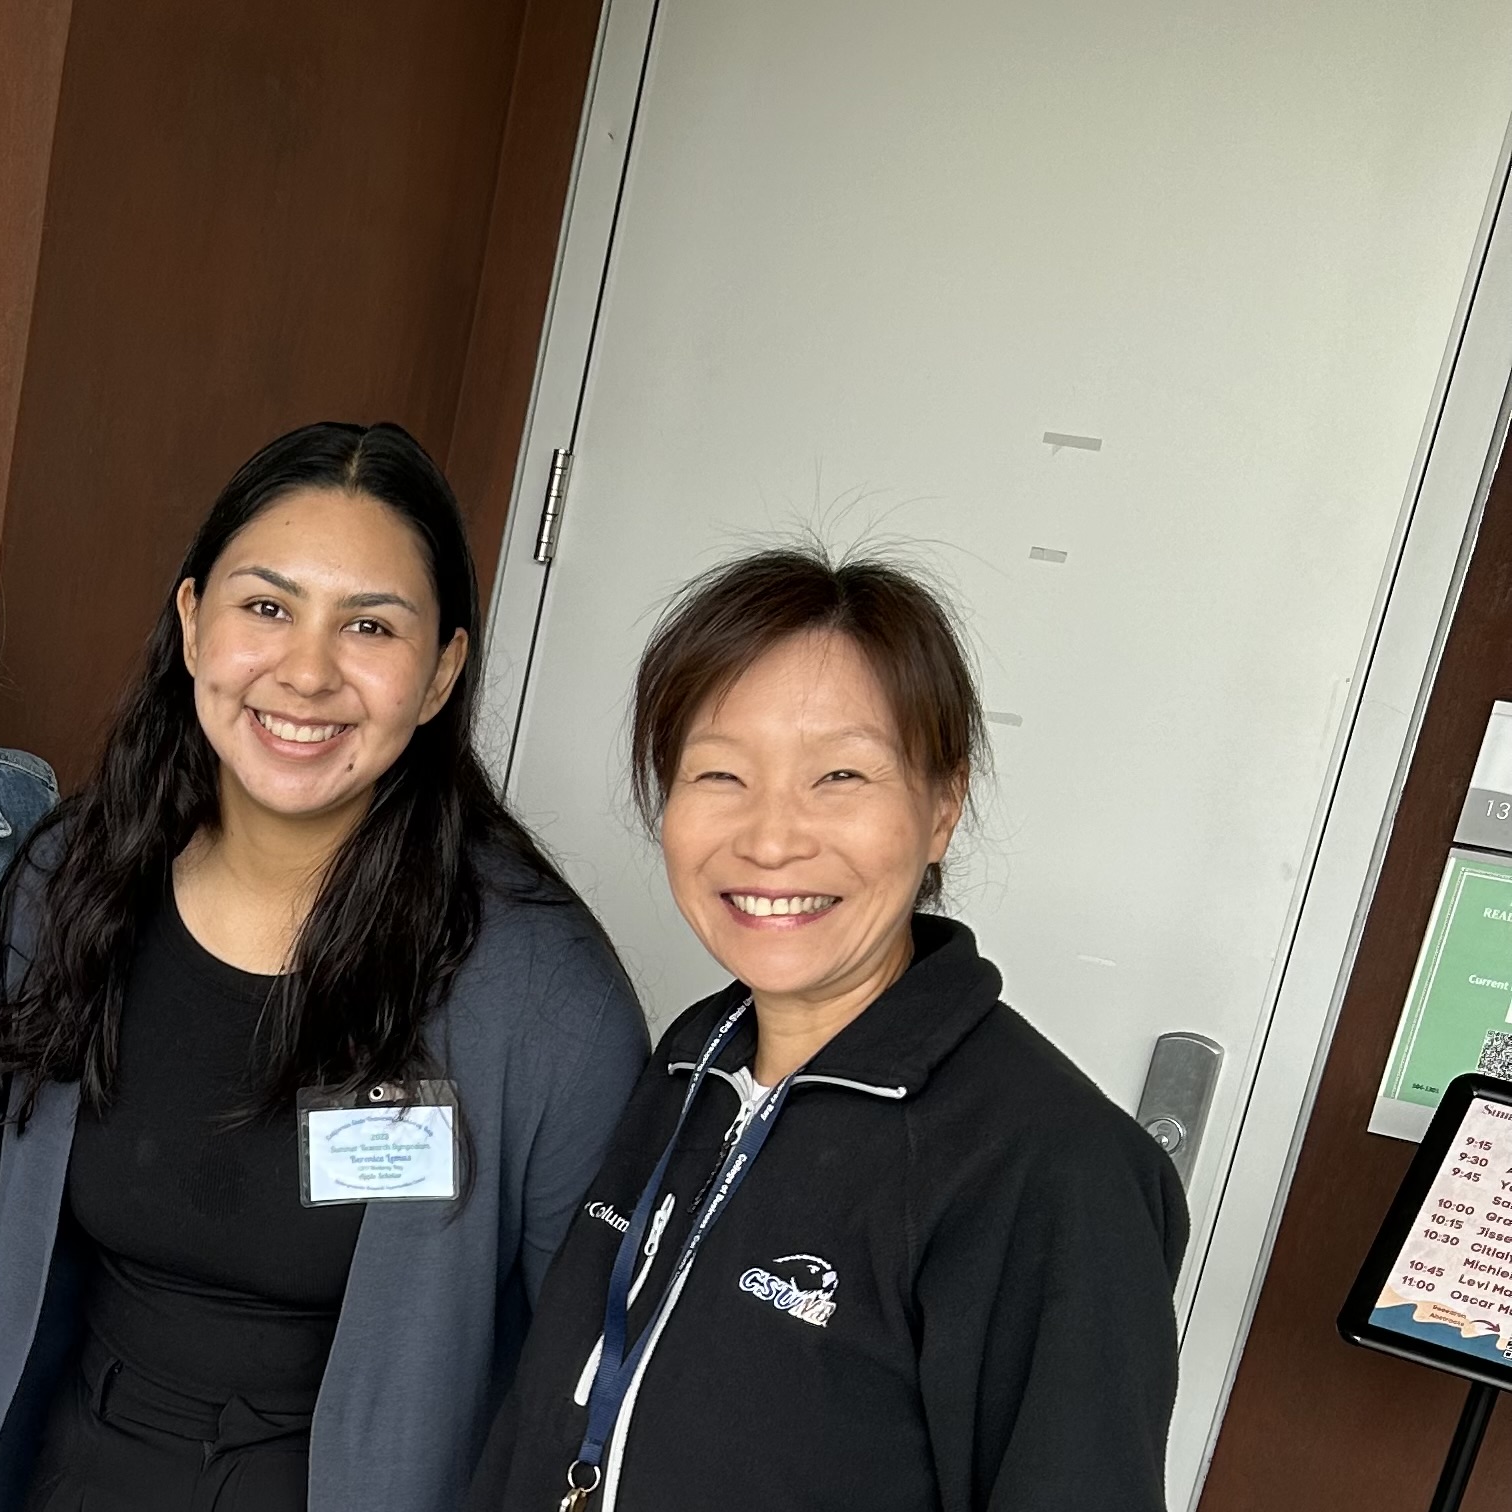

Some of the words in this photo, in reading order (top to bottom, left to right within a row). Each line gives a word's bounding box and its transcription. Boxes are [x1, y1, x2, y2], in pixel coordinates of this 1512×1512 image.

[1468, 974, 1509, 991] Current
[1466, 1137, 1493, 1151] 9:15
[1458, 1152, 1489, 1167] 9:30
[1451, 1167, 1482, 1182] 9:45
[1438, 1198, 1475, 1215] 10:00
[1431, 1213, 1464, 1230] 10:15
[1423, 1229, 1460, 1246] 10:30
[1409, 1260, 1445, 1277] 10:45
[1458, 1274, 1490, 1291] Levi
[1402, 1275, 1435, 1292] 11:00
[1450, 1290, 1495, 1310] Oscar
